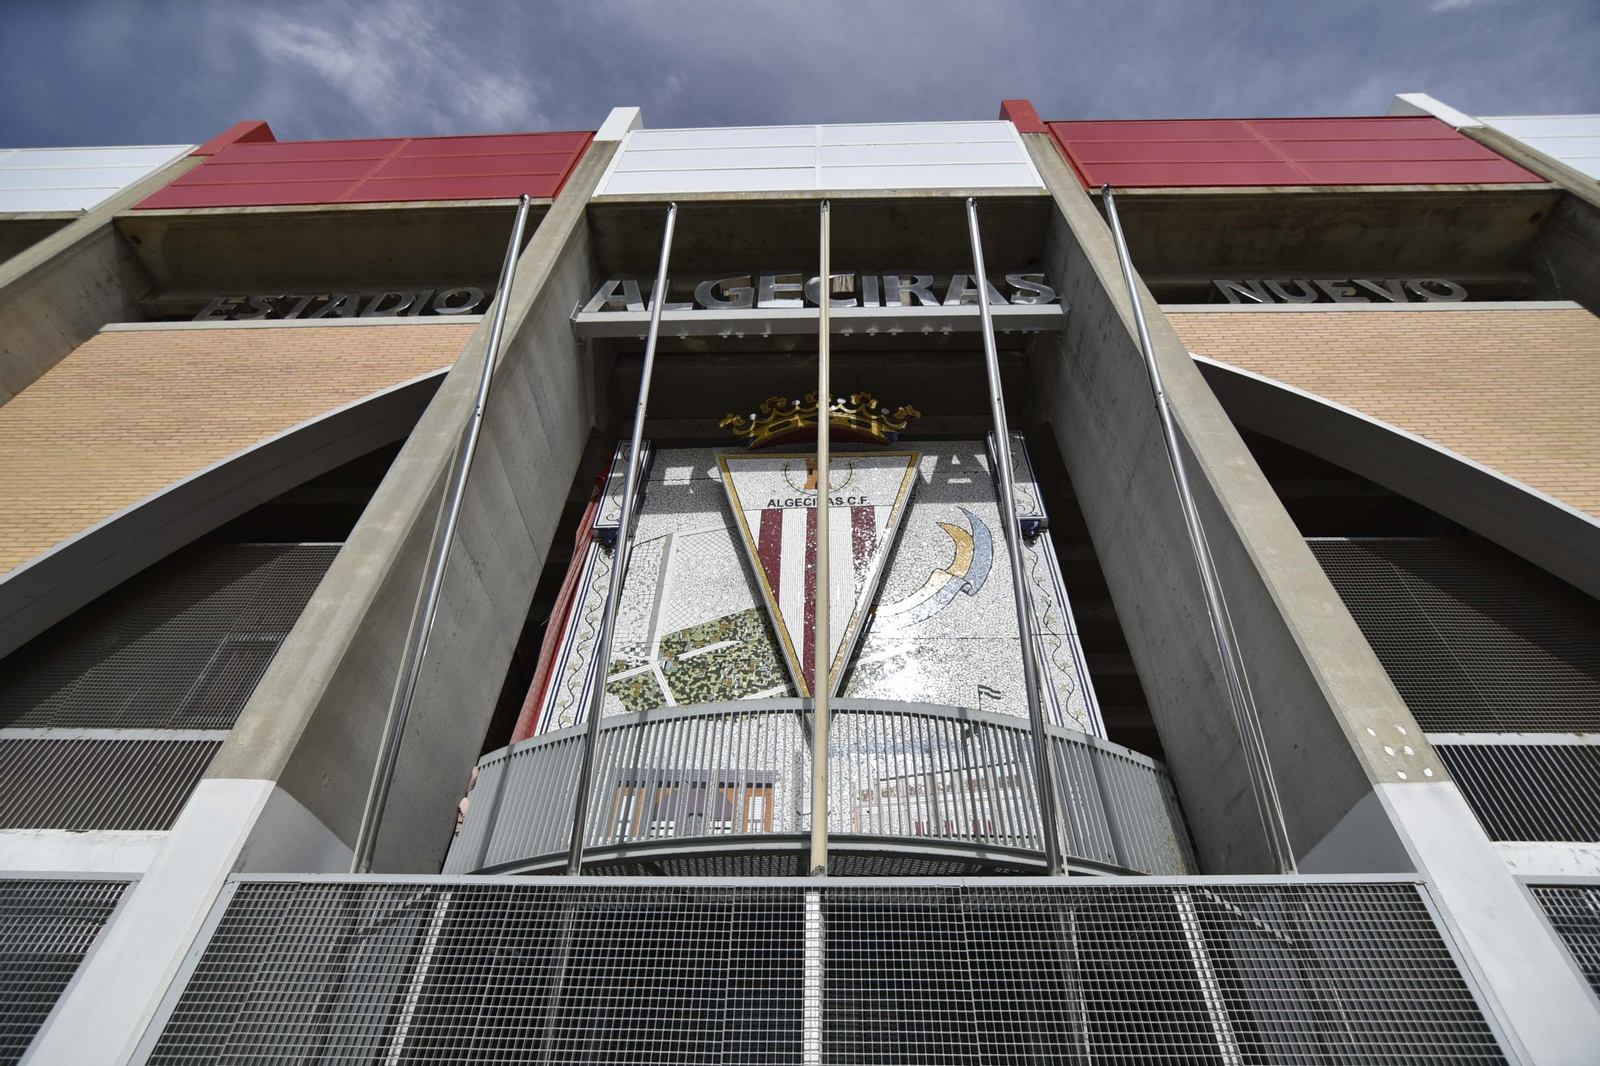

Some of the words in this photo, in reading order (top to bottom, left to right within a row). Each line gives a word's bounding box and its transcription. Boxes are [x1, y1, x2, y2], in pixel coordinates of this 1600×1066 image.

[193, 286, 486, 320] ESTADIO
[581, 272, 1057, 312] ALGECIRAS
[1212, 278, 1469, 304] NUEVO
[767, 496, 844, 508] ALGECIAS
[847, 495, 871, 506] C.F.
